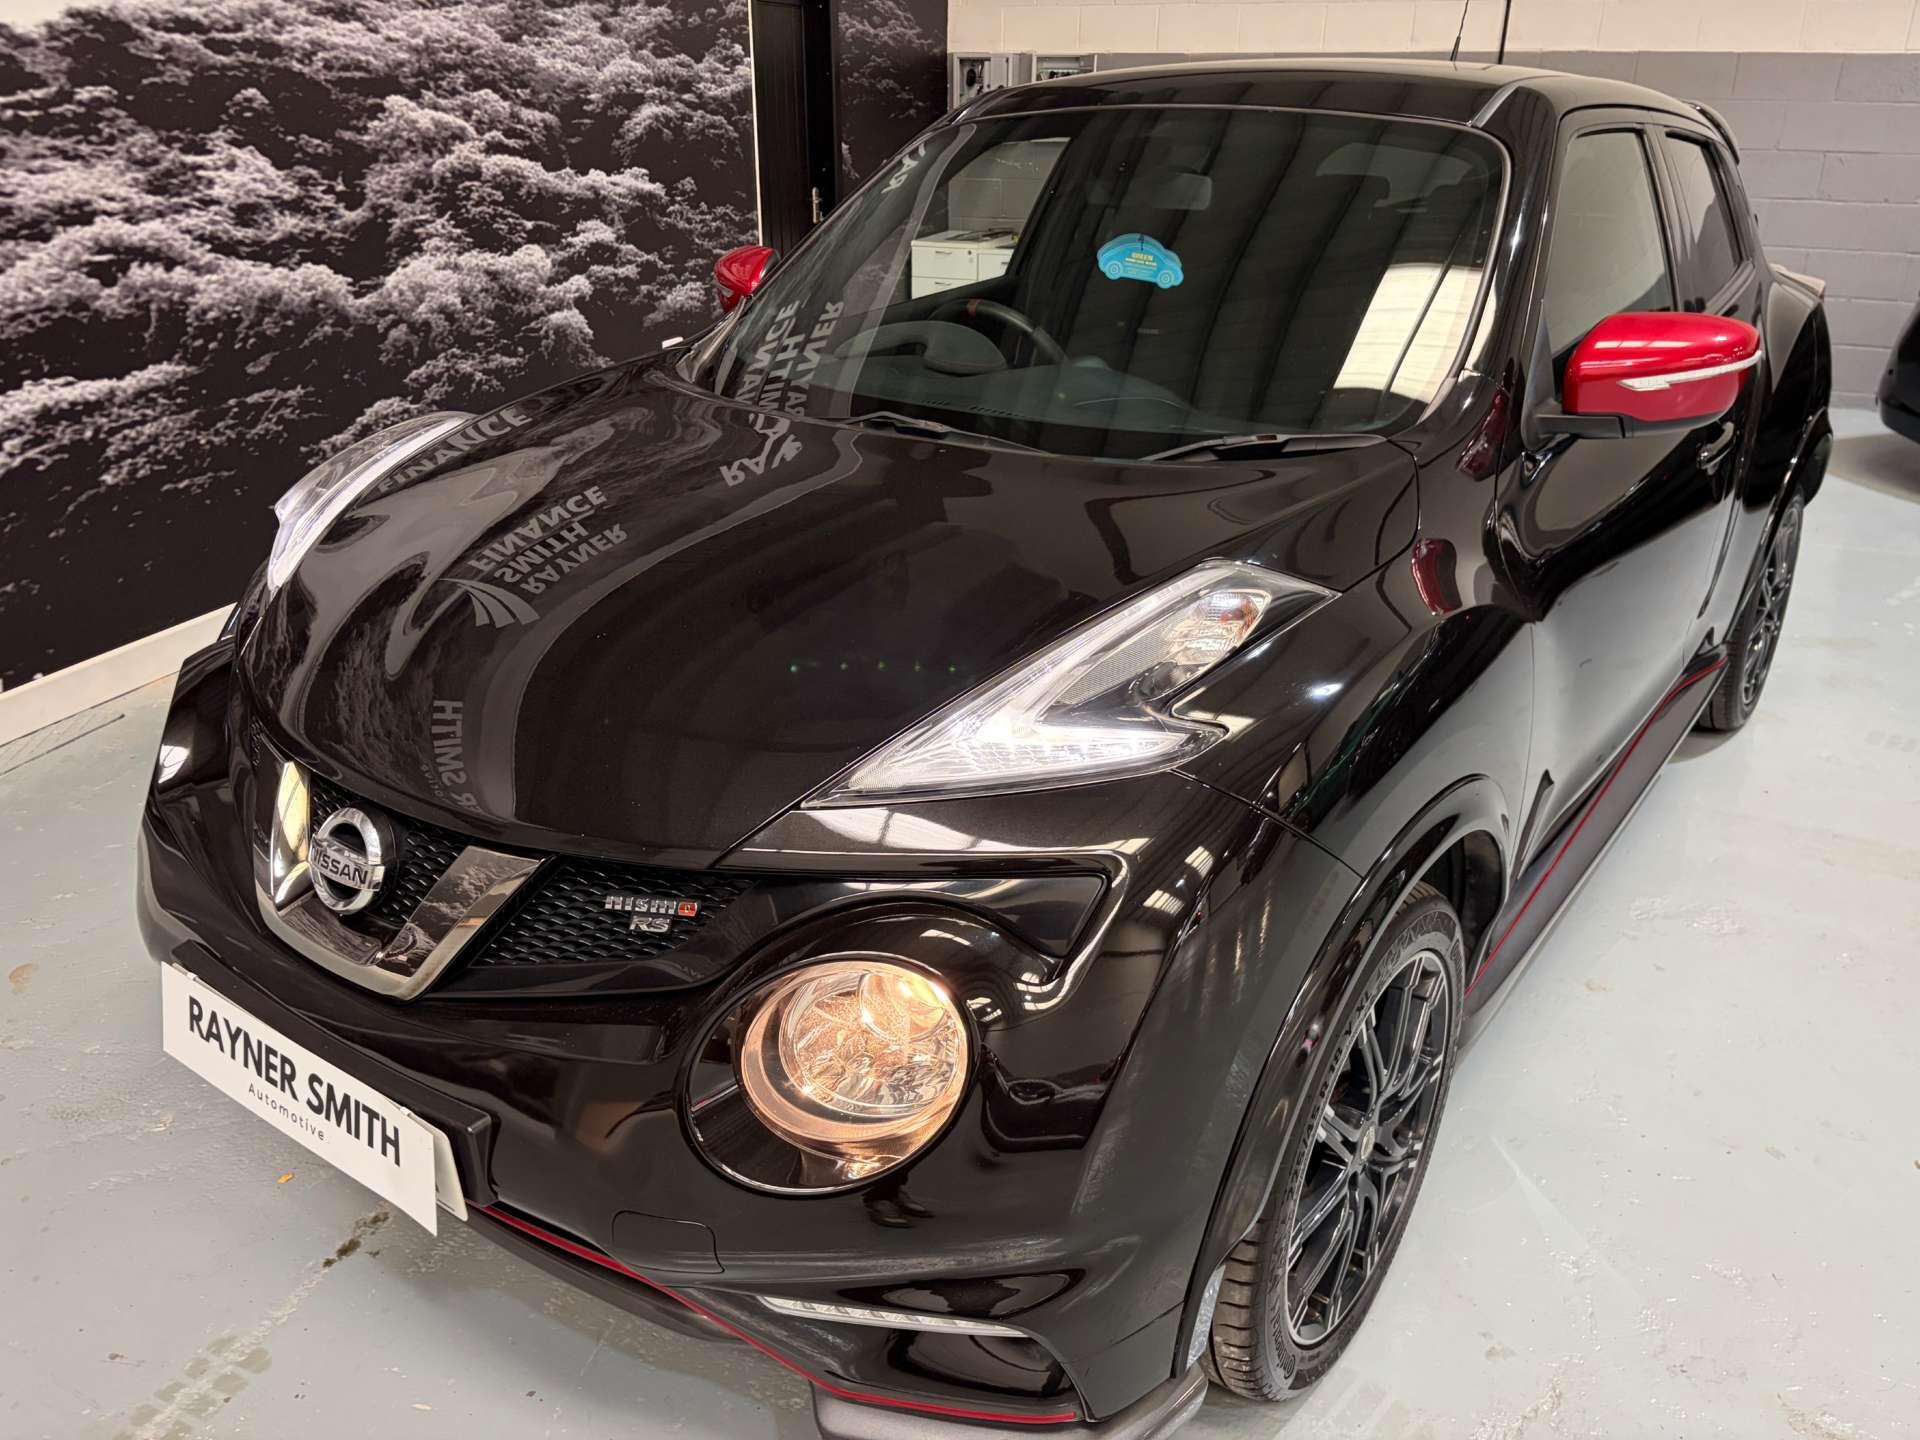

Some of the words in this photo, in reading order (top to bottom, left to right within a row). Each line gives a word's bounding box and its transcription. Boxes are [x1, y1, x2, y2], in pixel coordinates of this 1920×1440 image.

[312, 842, 368, 885] NISSAN
[629, 915, 671, 933] RS
[188, 995, 300, 1103] RAYNER
[306, 1072, 401, 1168] SMITH
